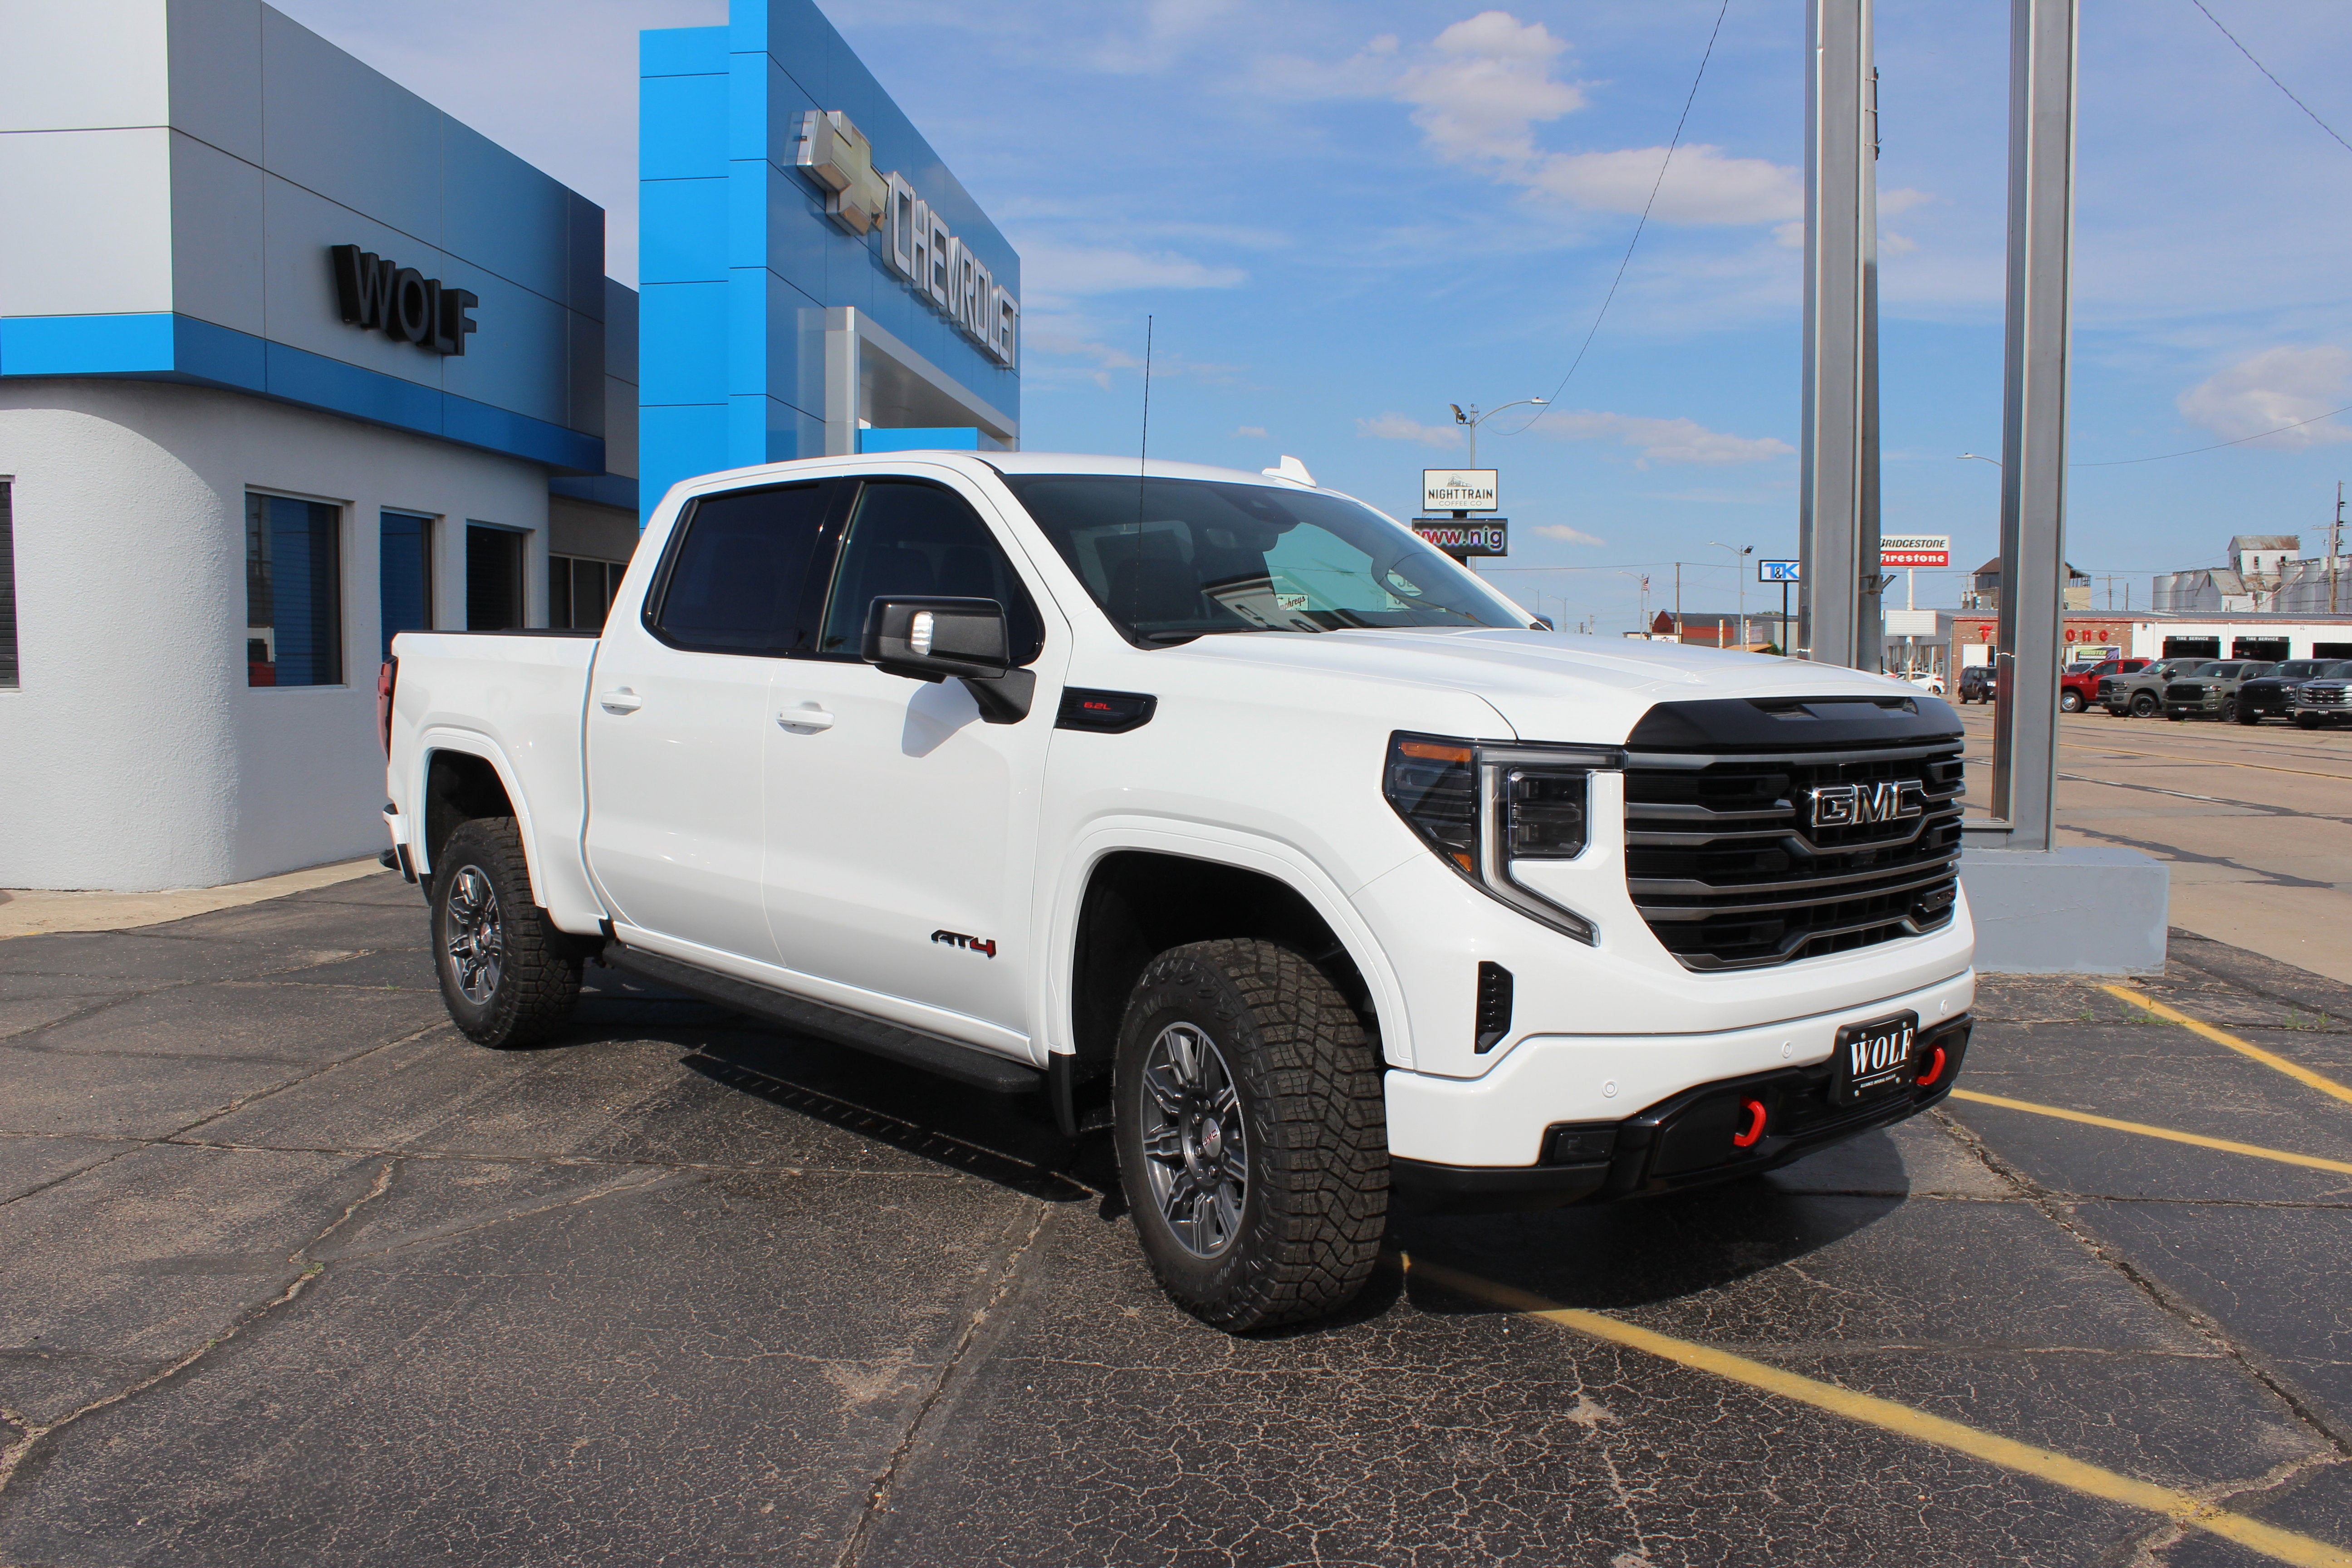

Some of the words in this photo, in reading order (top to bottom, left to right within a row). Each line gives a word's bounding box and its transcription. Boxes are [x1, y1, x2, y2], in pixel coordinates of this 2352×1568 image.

[882, 172, 1020, 369] CHEVROLET
[332, 244, 478, 356] WOLF
[1428, 489, 1460, 499] NIGHT
[1461, 489, 1493, 499] TRAIN
[1415, 527, 1503, 549] ww.nig
[1084, 702, 1111, 710] 6.2L
[1811, 780, 1923, 827] GMC
[931, 930, 996, 958] AT4
[1850, 1028, 1914, 1075] WOLF
[1203, 1129, 1218, 1146] GMC
